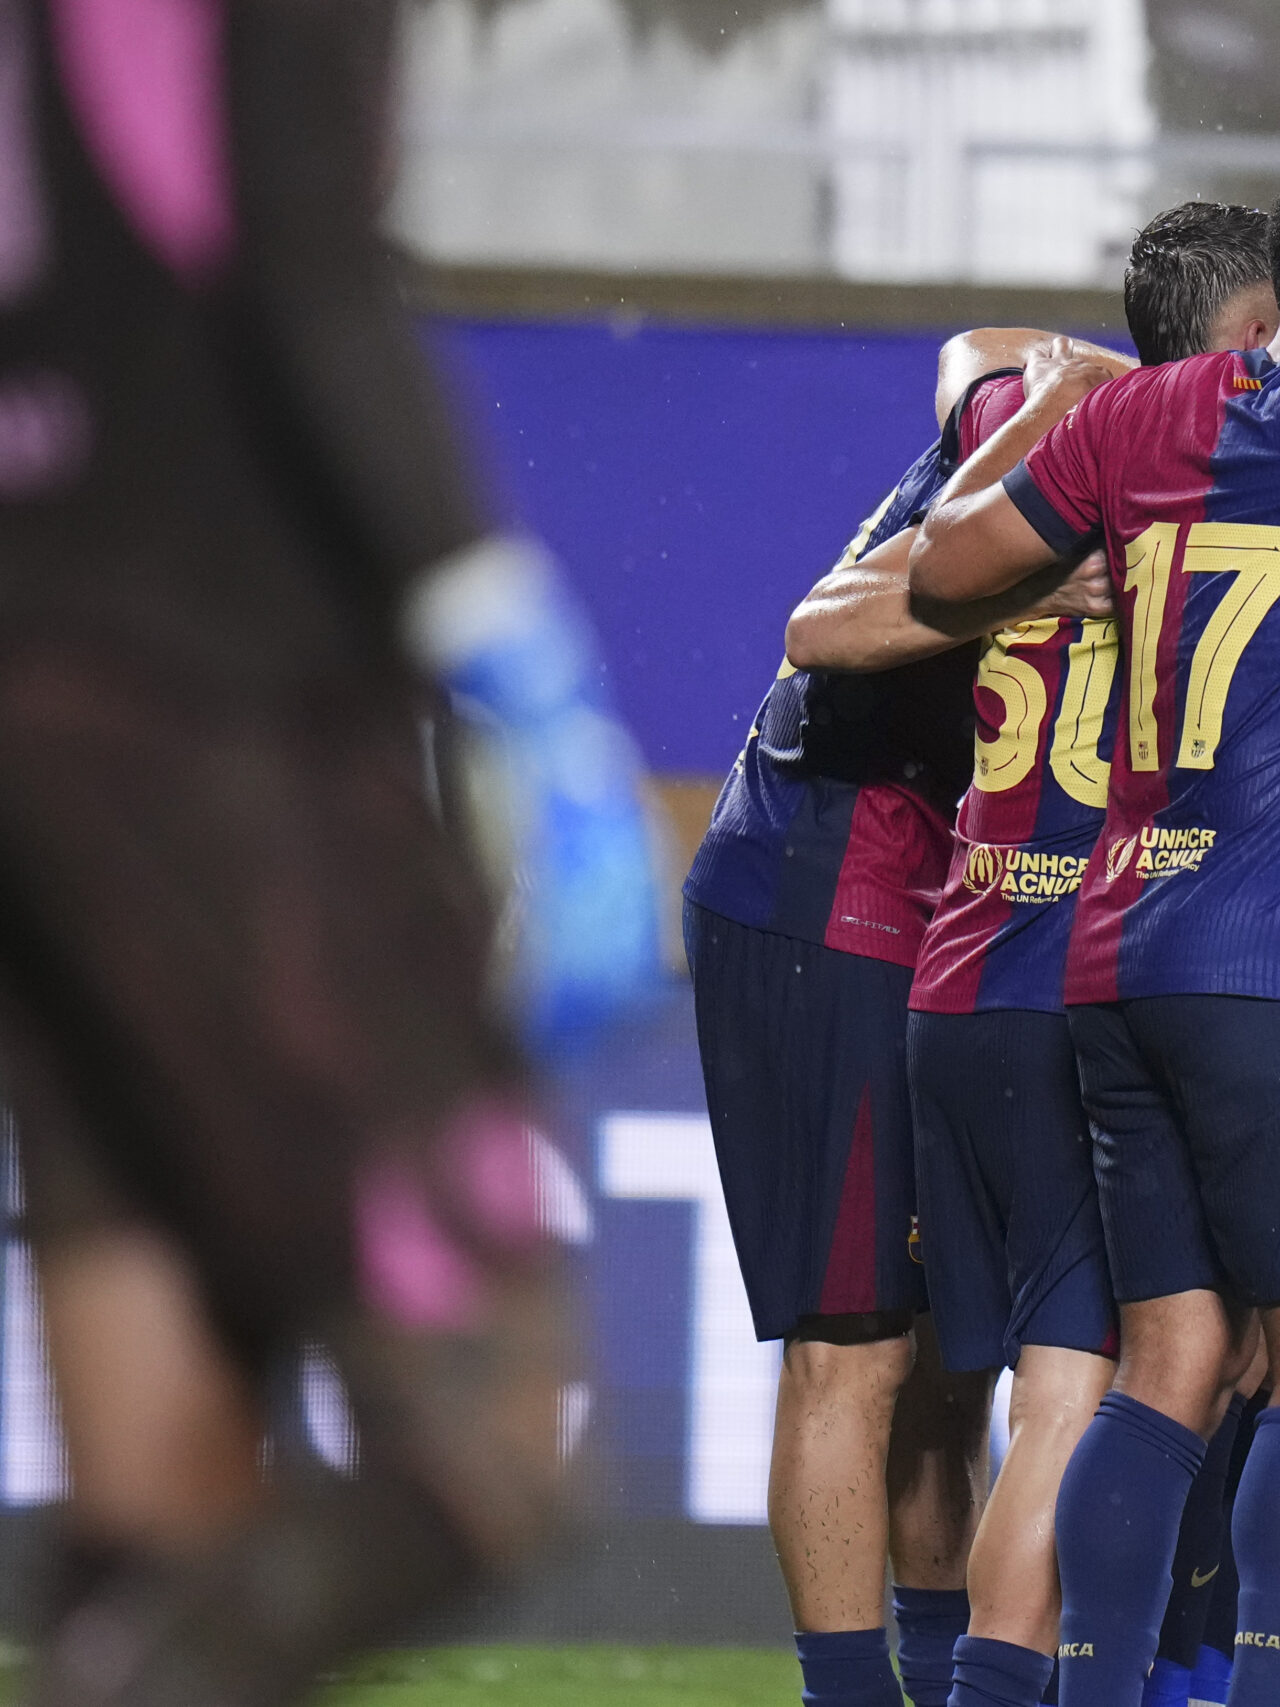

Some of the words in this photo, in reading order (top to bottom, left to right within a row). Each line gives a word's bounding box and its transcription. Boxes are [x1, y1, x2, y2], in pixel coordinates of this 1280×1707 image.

[1140, 826, 1217, 848] UNHCR
[1001, 892, 1016, 903] The
[1016, 894, 1030, 903] UN
